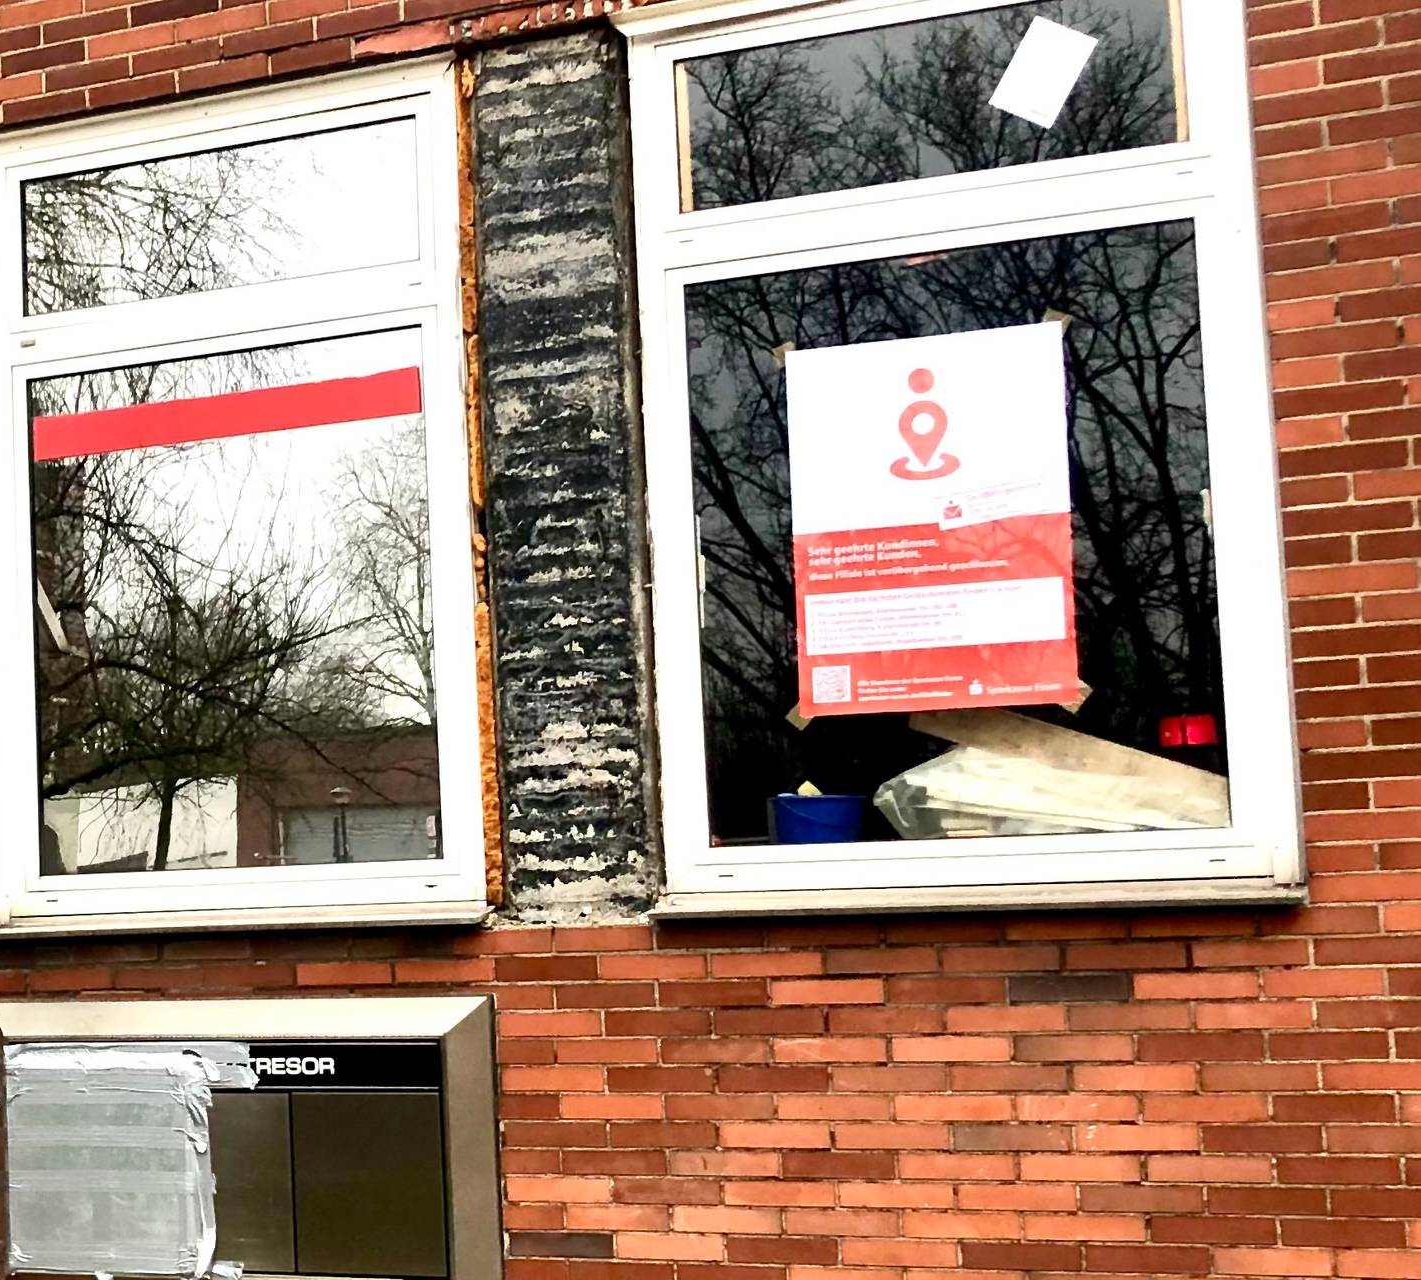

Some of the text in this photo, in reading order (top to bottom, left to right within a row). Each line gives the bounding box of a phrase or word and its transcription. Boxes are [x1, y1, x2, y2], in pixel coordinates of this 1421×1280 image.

[808, 546, 832, 557] Sehr
[834, 543, 875, 556] geehrte
[808, 550, 922, 566] sehr geehrte Kunden,
